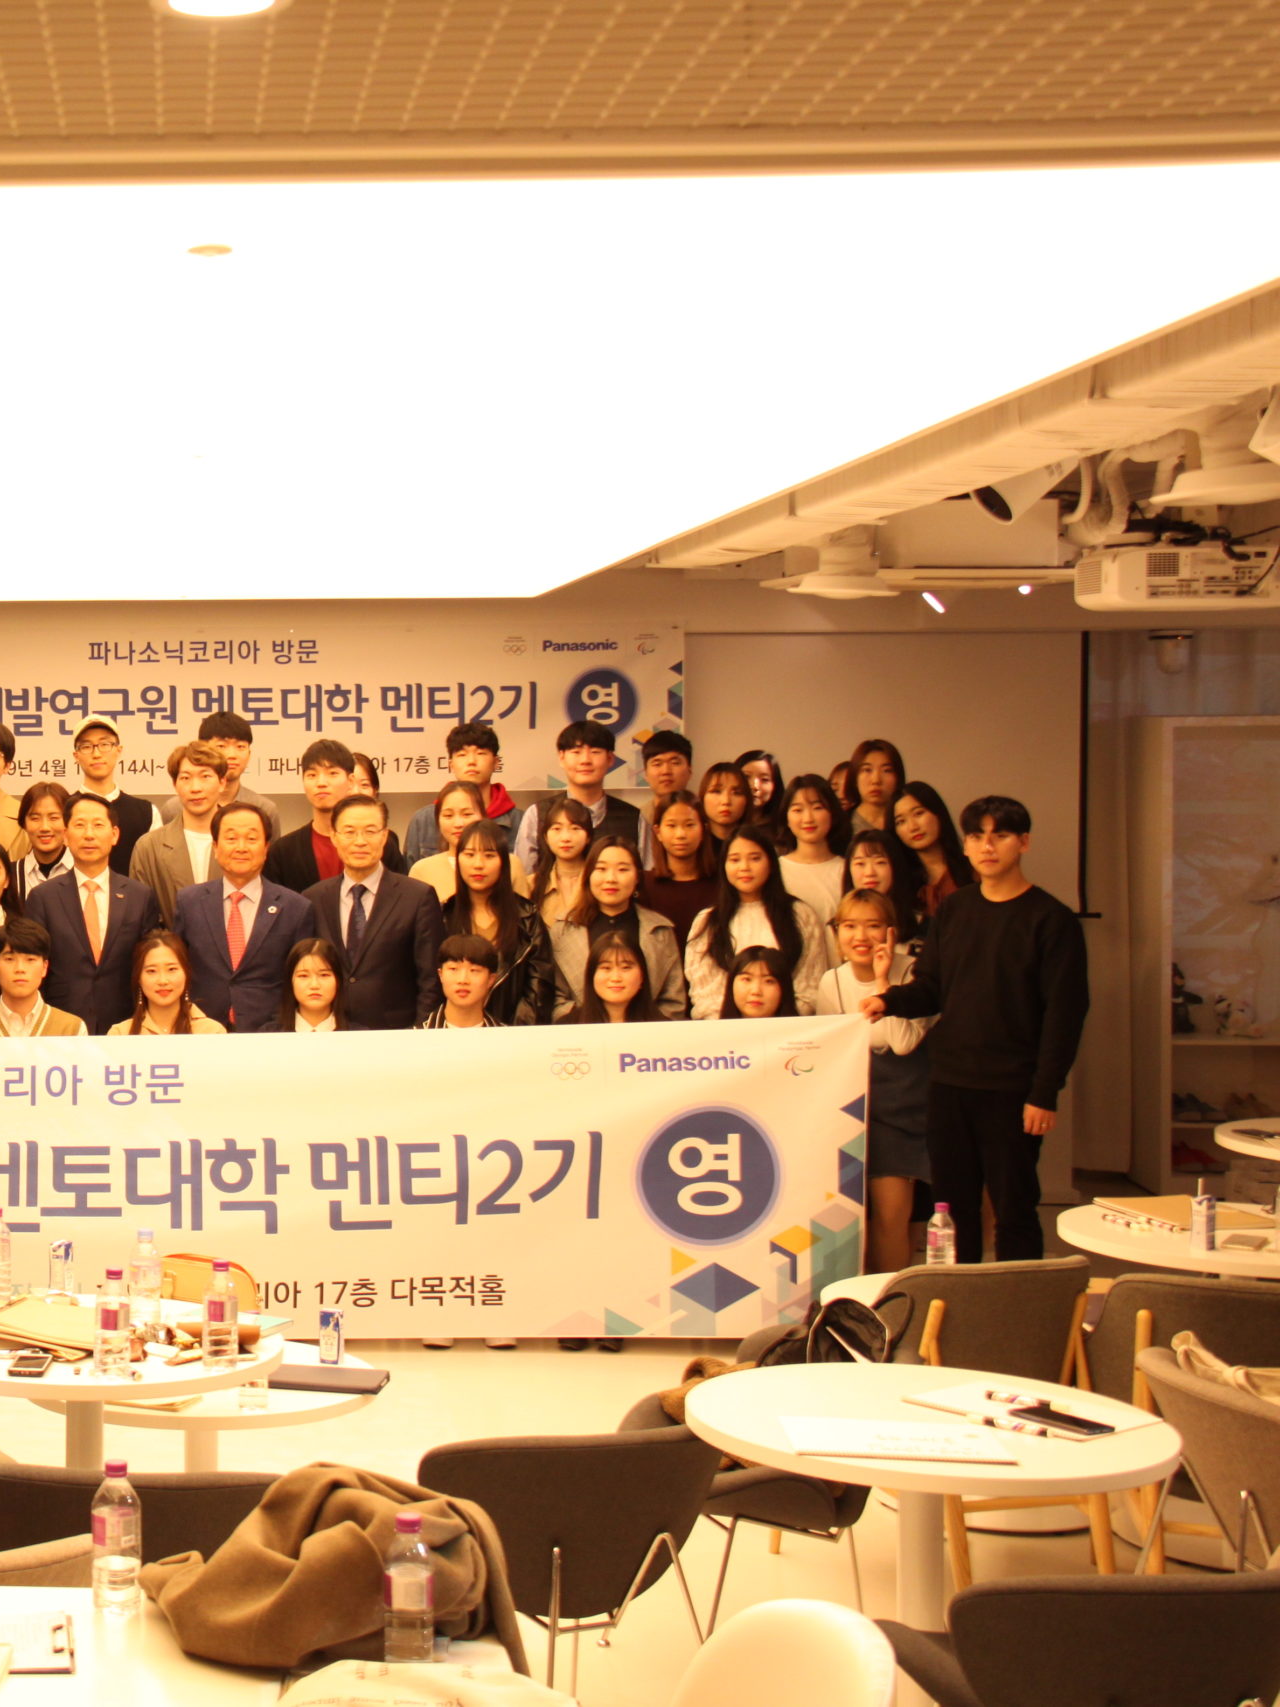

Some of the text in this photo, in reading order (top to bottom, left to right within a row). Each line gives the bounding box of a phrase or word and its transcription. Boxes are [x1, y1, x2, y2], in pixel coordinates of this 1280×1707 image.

[89, 638, 320, 666] 파나소닉코리아 방문
[542, 638, 618, 652] Panasonic
[191, 682, 369, 735] 멘토대학
[380, 681, 538, 734] 멘티2기
[579, 682, 620, 724] 영
[38, 758, 67, 777] 4월
[393, 756, 431, 775] 17층
[619, 1050, 751, 1073] Panasonic
[104, 1063, 185, 1106] 방문
[308, 1131, 602, 1231] 멘티2기
[667, 1132, 744, 1216] 영
[313, 1279, 378, 1307] 17층
[390, 1274, 507, 1307] 다목적홀
